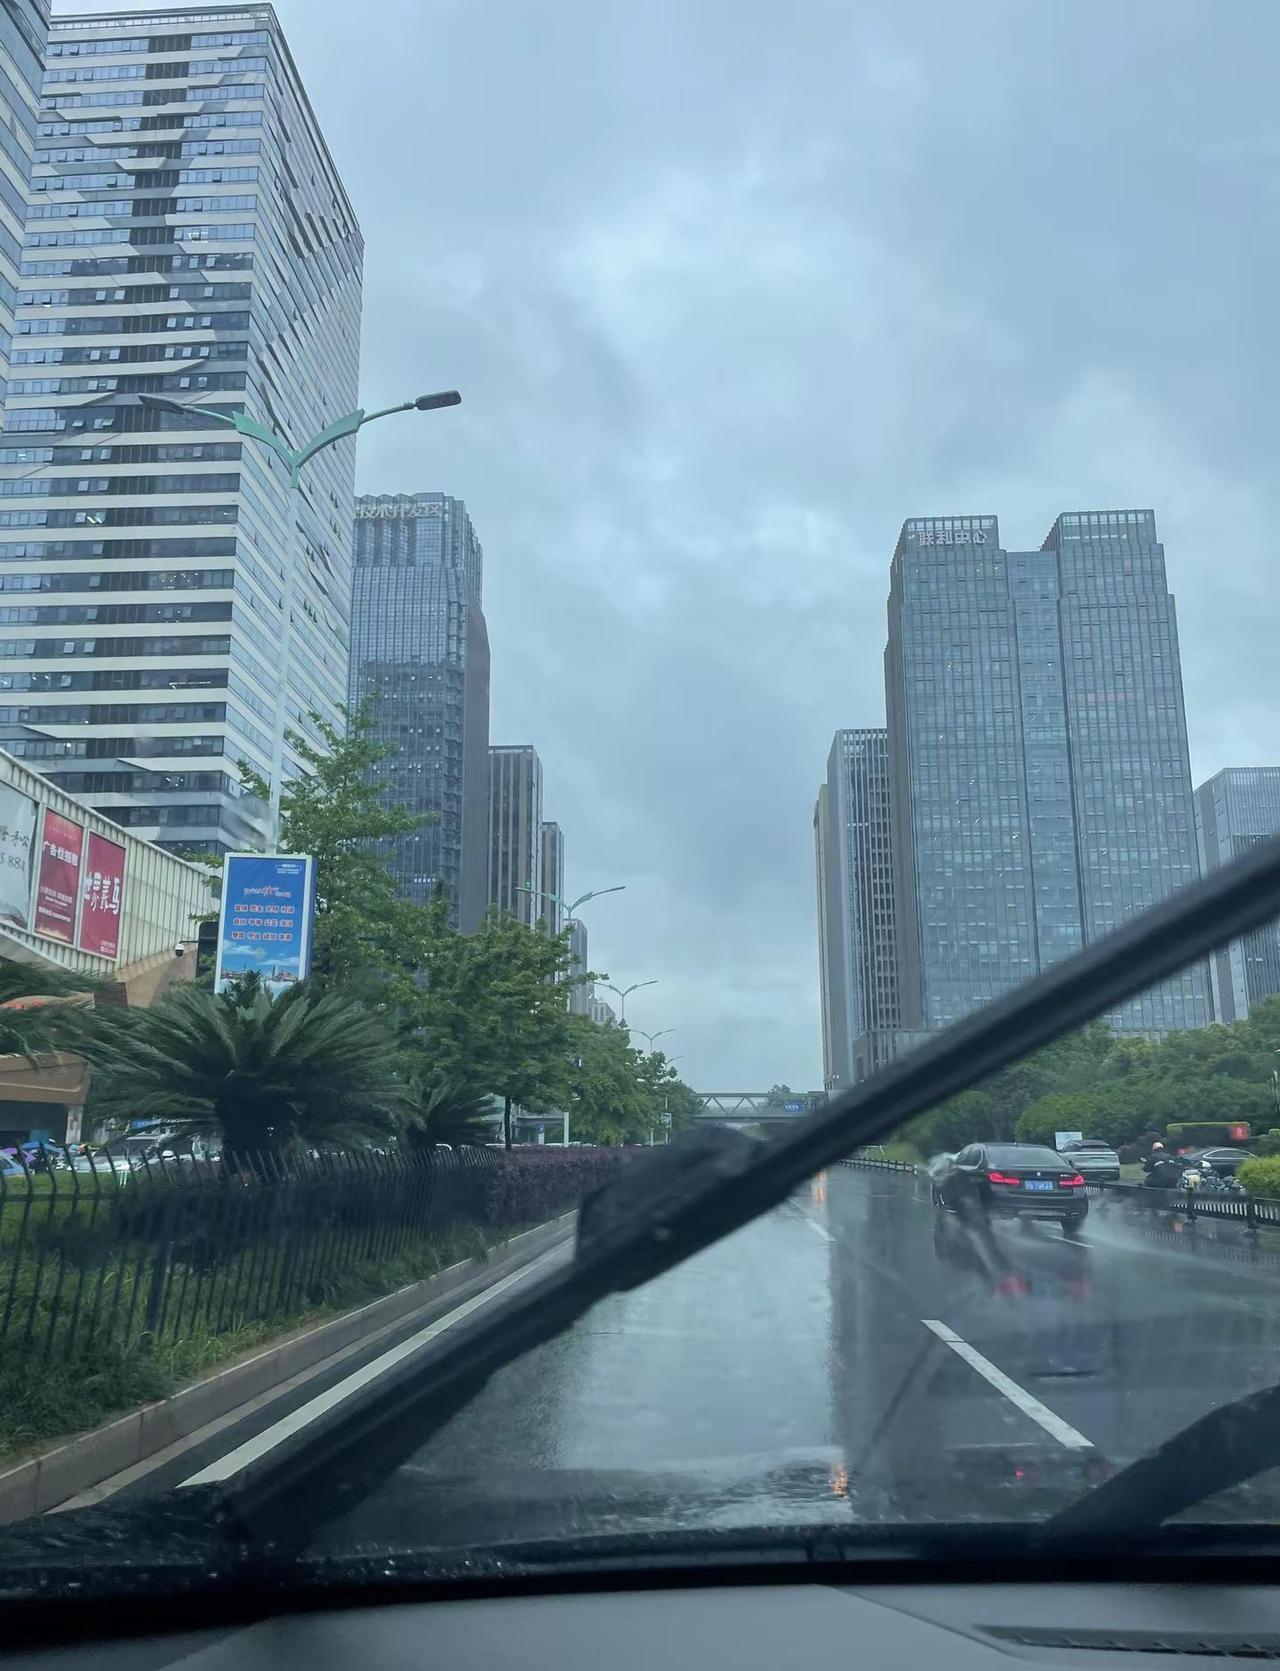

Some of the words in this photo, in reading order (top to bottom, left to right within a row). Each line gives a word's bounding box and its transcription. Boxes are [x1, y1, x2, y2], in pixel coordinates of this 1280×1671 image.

[353, 502, 441, 519] 技术开发区
[42, 840, 78, 867] 广告位招租
